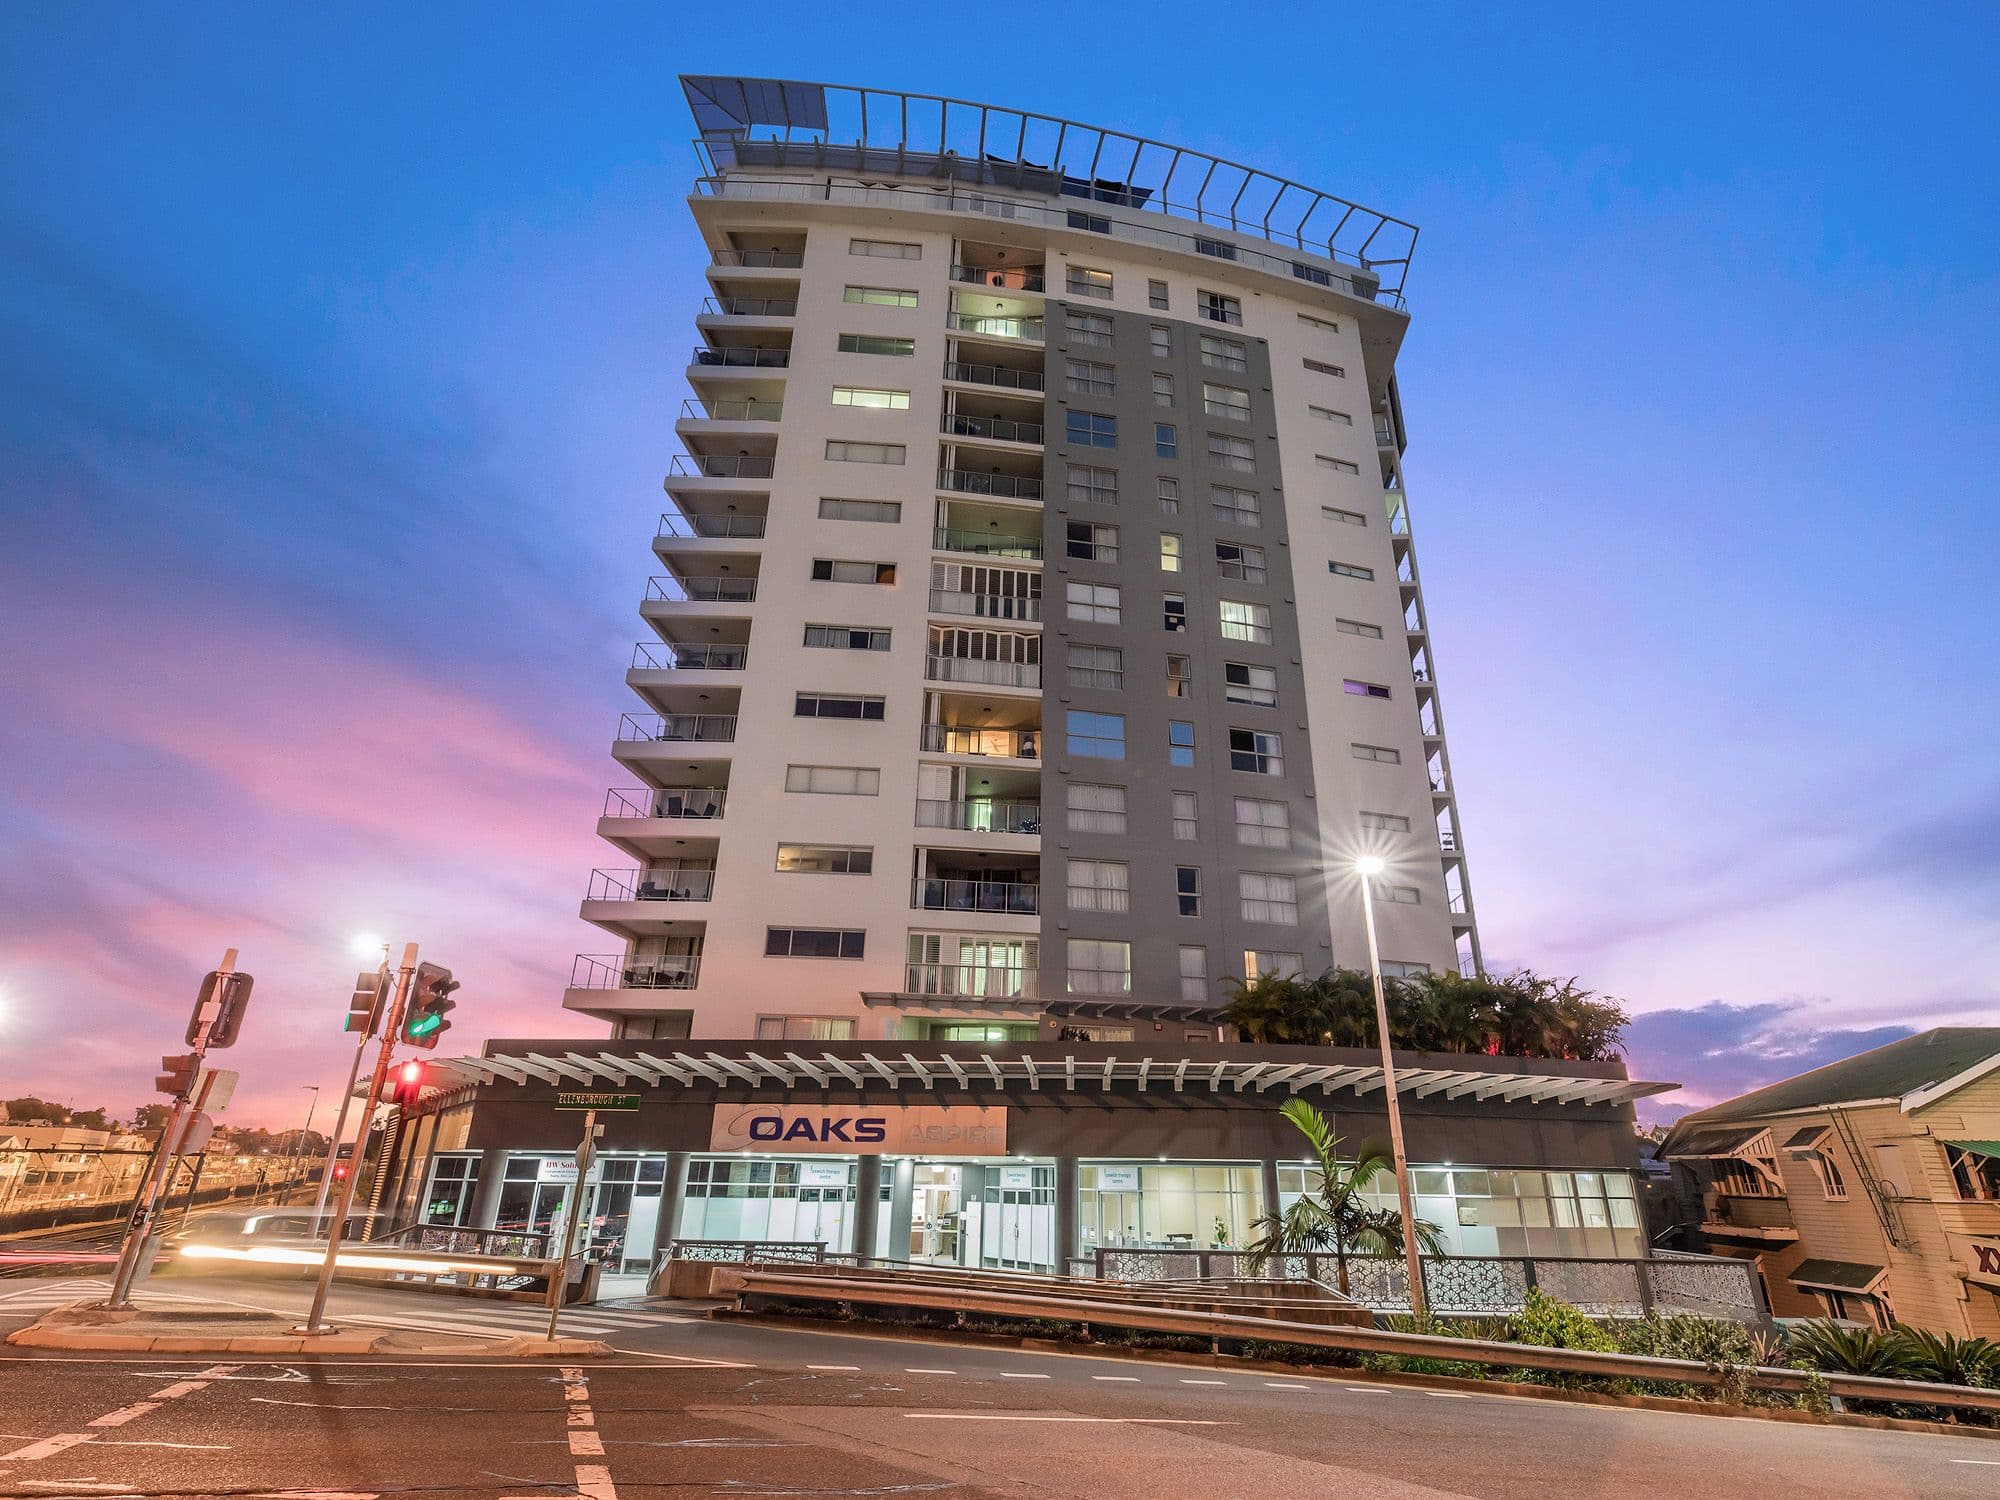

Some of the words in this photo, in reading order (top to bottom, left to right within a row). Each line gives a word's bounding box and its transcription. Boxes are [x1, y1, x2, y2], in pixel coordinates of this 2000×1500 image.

[558, 1094, 614, 1105] ELLENBOROUGH
[617, 1095, 626, 1105] ST
[750, 1117, 886, 1142] OAKS
[905, 1125, 1002, 1144] ASPIRE
